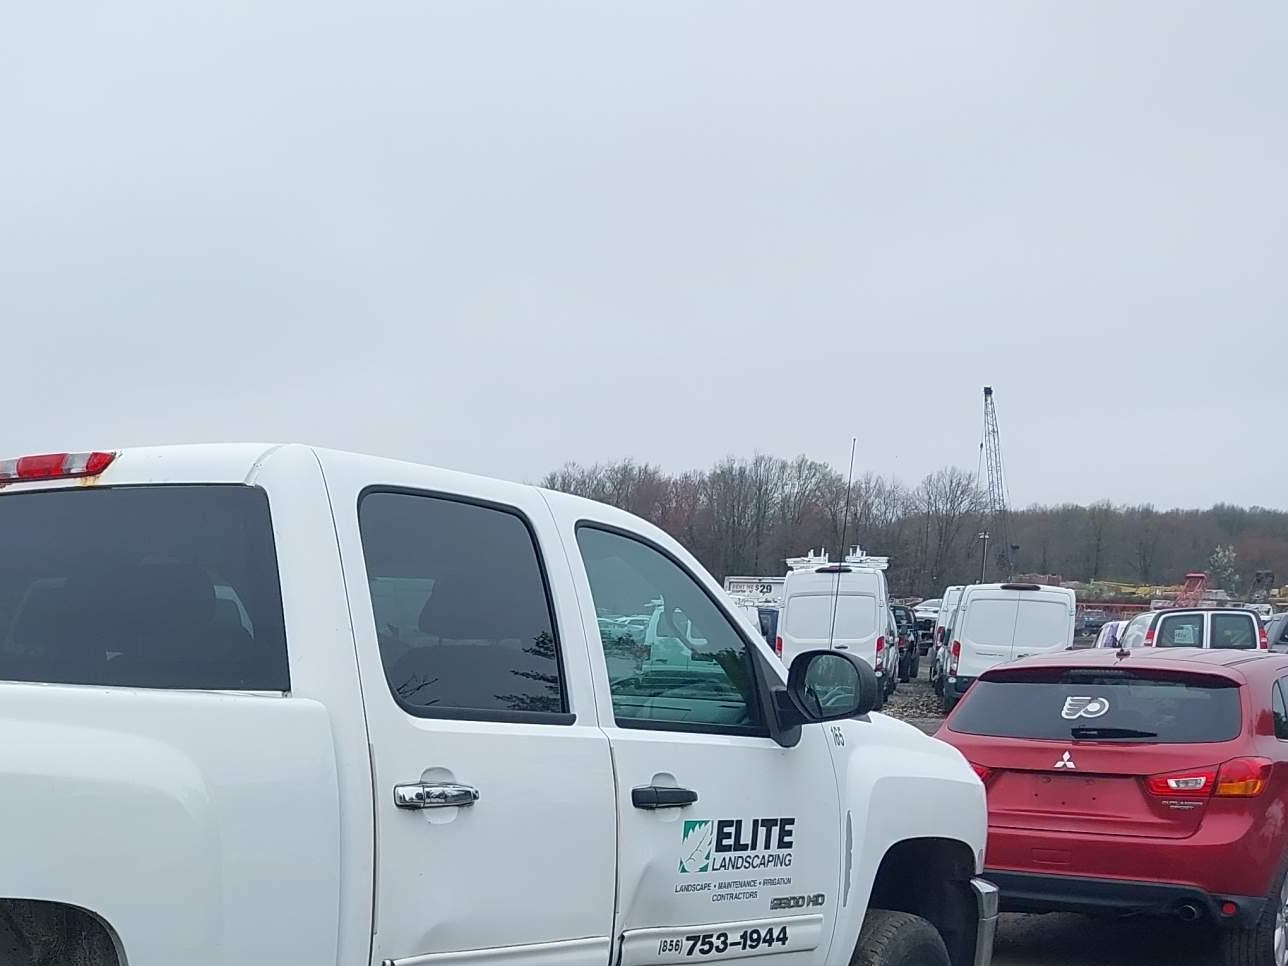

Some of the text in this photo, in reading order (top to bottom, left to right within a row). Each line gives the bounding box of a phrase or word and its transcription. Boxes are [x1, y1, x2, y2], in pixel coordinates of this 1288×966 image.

[830, 726, 845, 746] 165
[715, 817, 796, 853] ELITE
[712, 852, 792, 872] LANDSCAPING
[674, 877, 792, 893] LANDSCAPE MAINTENANCE IRRIGATION
[711, 890, 758, 902] CONTRACTORS
[657, 925, 788, 957] (856) 753-1944
